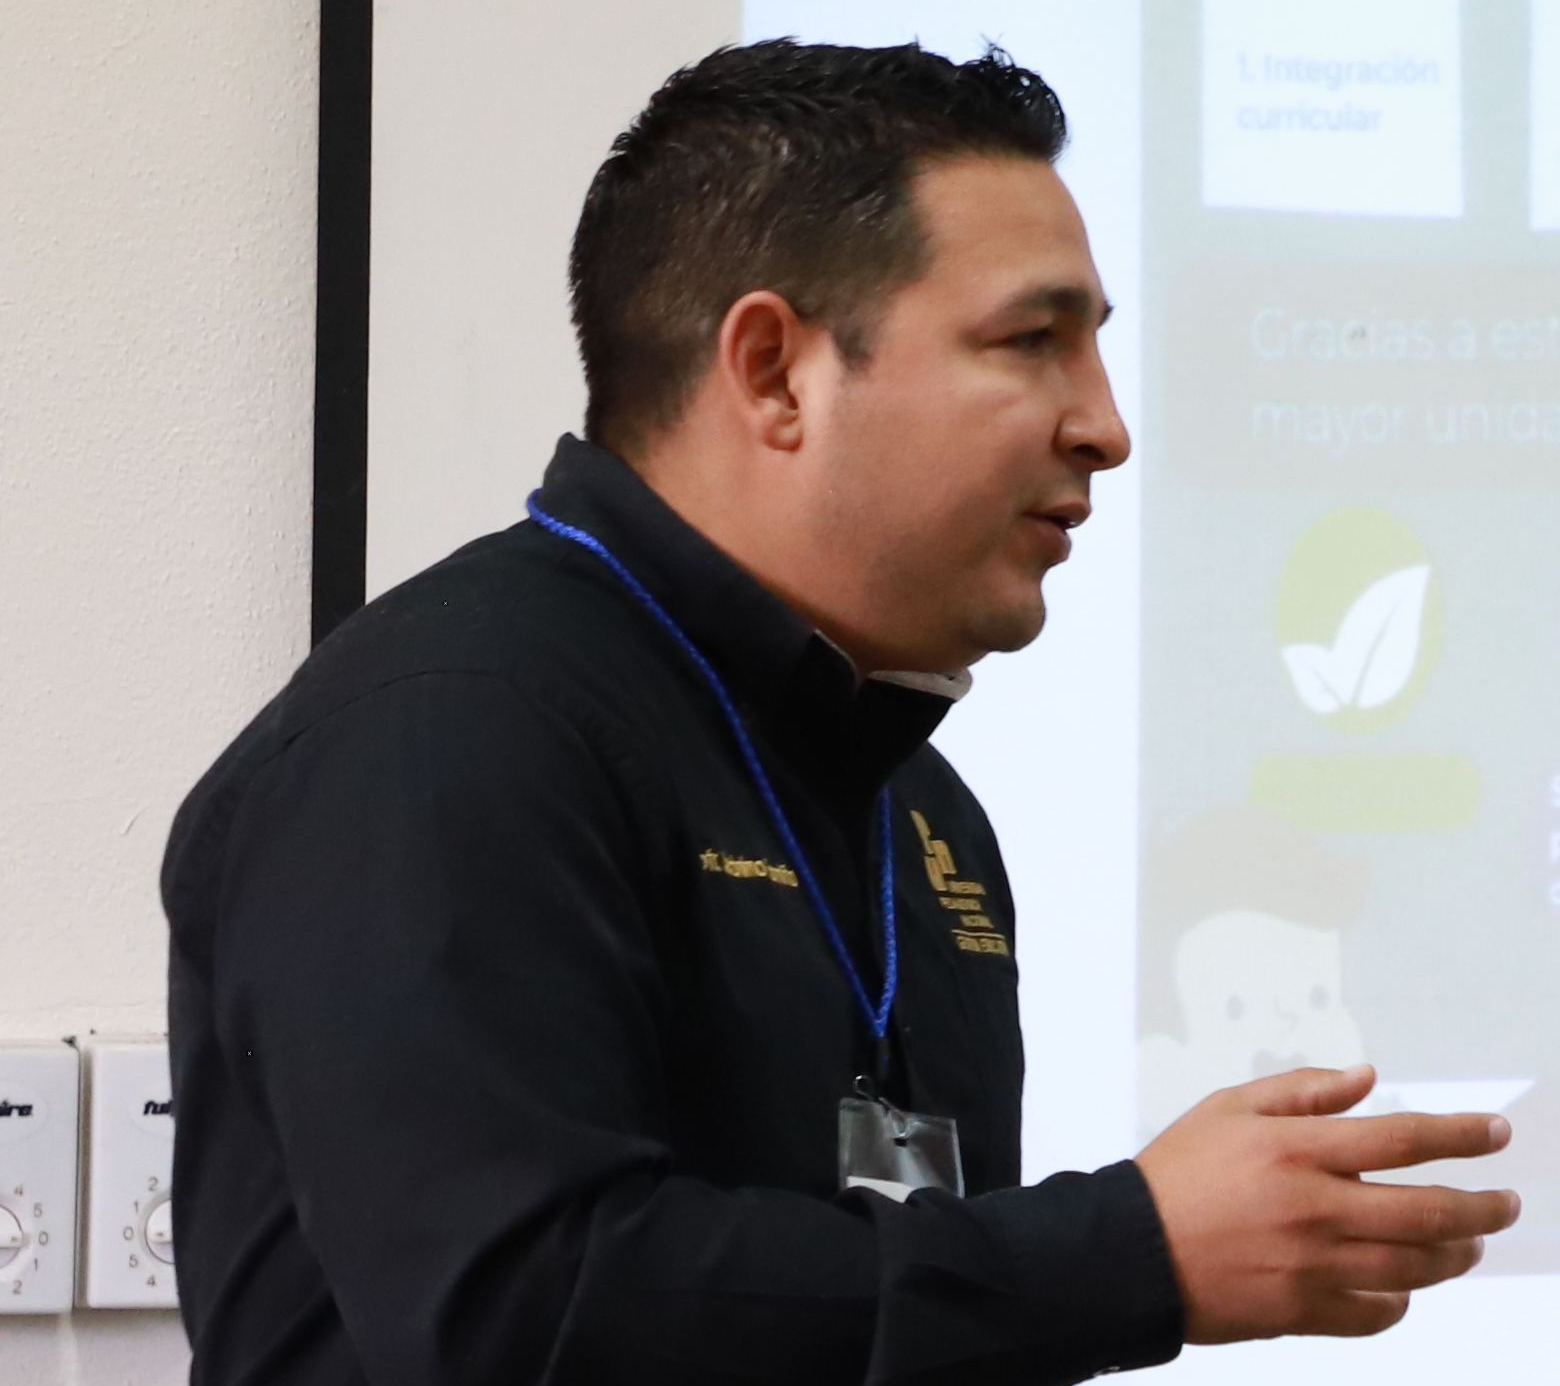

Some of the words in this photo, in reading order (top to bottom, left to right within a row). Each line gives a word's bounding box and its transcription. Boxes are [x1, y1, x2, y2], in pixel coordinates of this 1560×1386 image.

[1262, 51, 1441, 93] Integración
[1237, 99, 1383, 134] curricular
[1249, 303, 1438, 363] Gracias
[1446, 317, 1478, 363] a
[1251, 403, 1408, 457] mayor
[13, 1182, 24, 1197] 4
[33, 1203, 44, 1218] 5
[123, 1226, 134, 1241] 0
[148, 1177, 158, 1191] 2
[38, 1231, 49, 1246] 0
[12, 1280, 23, 1294] 2
[128, 1253, 139, 1268] 5
[146, 1274, 157, 1289] 4
